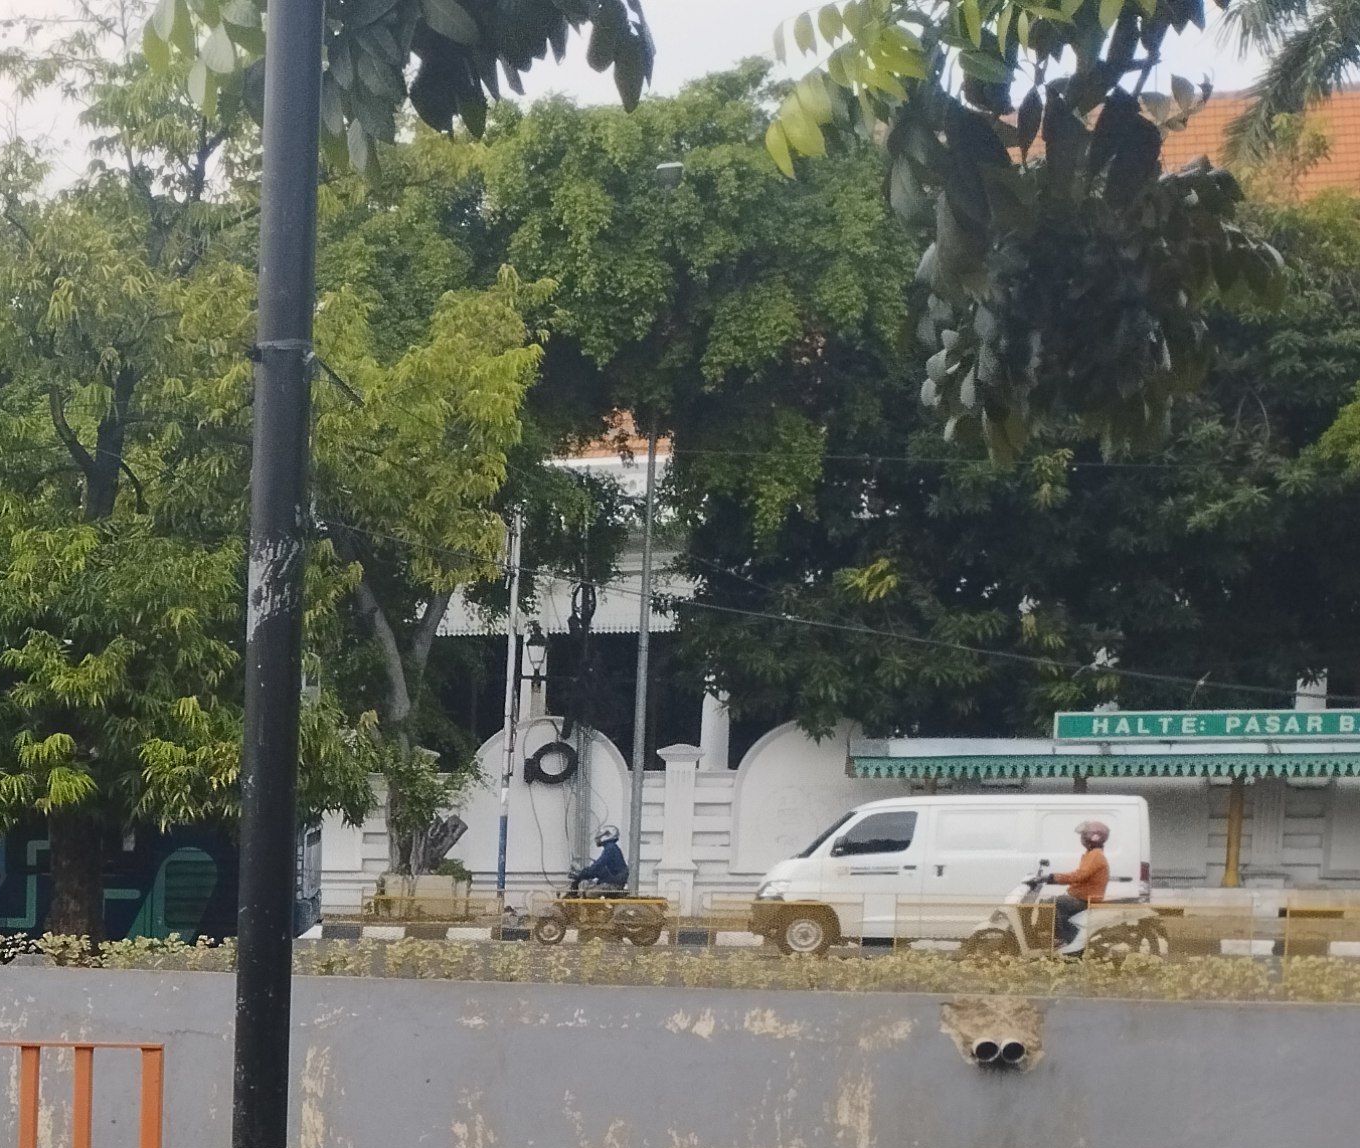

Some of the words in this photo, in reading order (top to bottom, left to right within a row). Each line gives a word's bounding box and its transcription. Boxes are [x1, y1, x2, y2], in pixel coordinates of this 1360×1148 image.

[1091, 717, 1206, 735] HALTE:
[1225, 714, 1323, 734] PASAR
[1339, 715, 1360, 732] B
